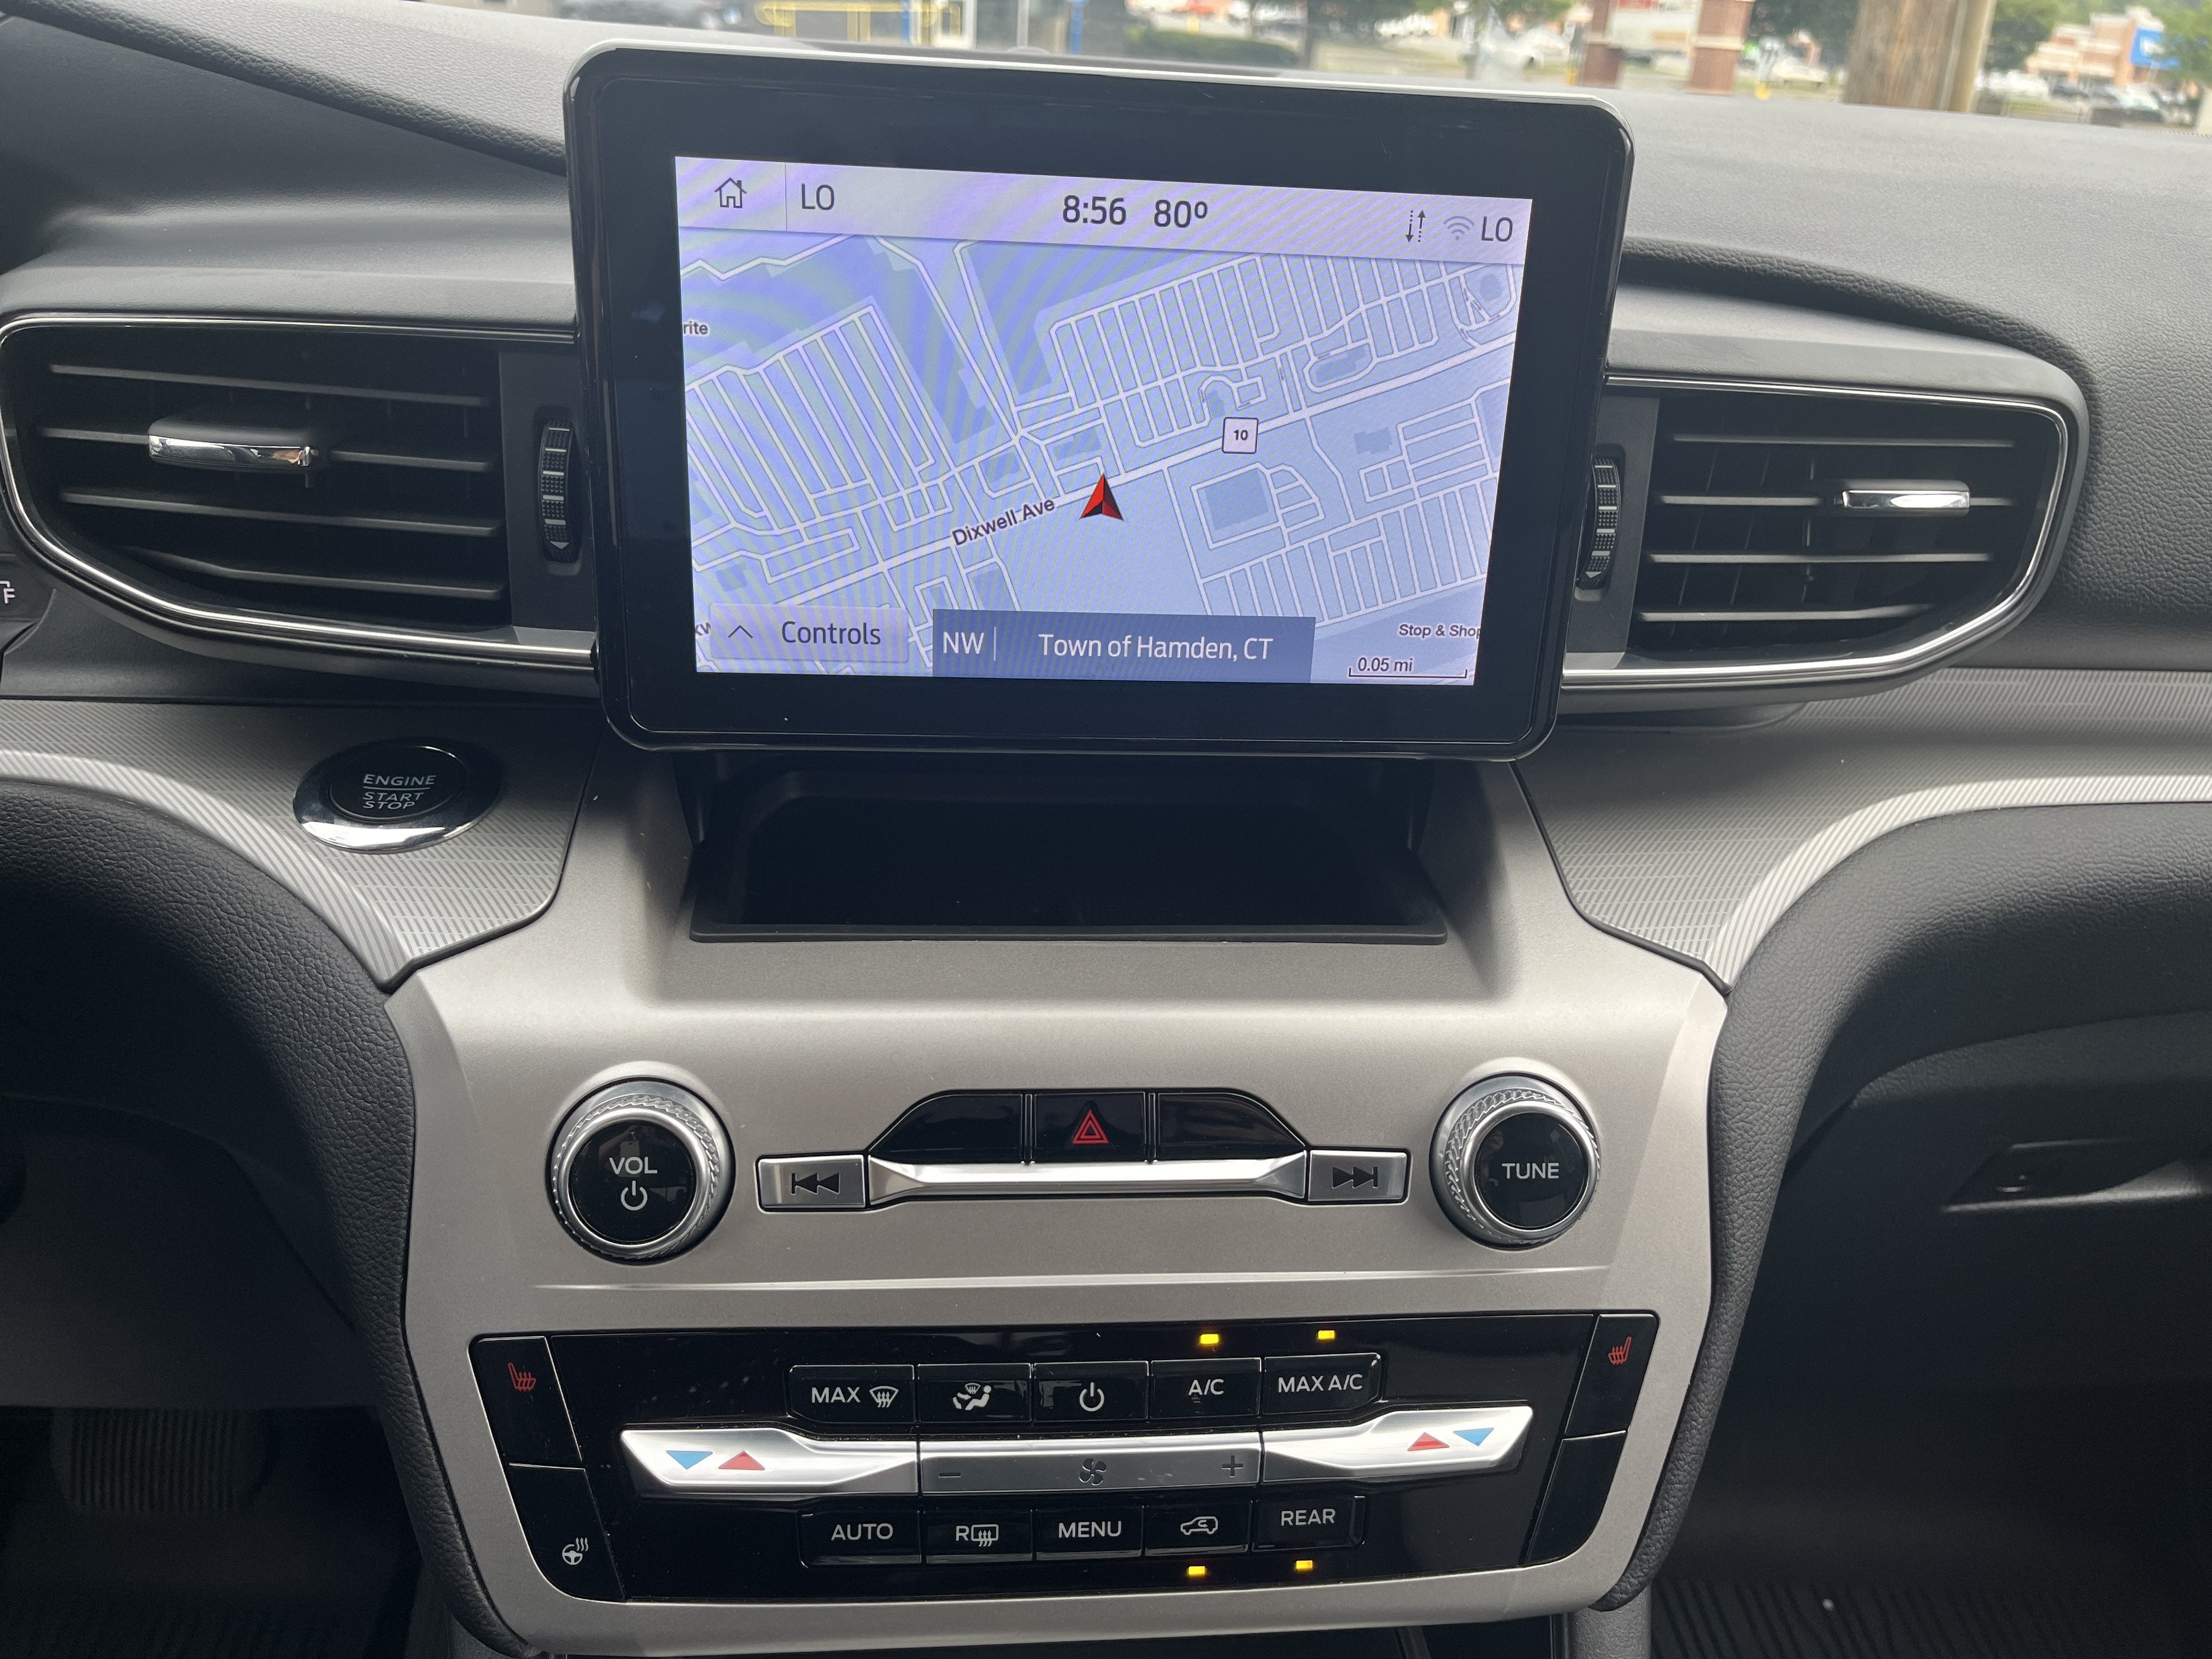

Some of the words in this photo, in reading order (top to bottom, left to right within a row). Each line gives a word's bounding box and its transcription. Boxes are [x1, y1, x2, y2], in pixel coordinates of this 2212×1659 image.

[800, 184, 835, 210] LO
[1063, 195, 1126, 225] 8:56
[1482, 217, 1513, 241] LO
[1233, 429, 1248, 441] 10
[952, 509, 1018, 546] Dixwell
[1023, 499, 1055, 521] Ave
[3, 588, 16, 604] F
[781, 621, 881, 645] Controls
[1399, 623, 1431, 639] Stop
[1435, 624, 1446, 636] &
[943, 632, 984, 654] NW
[1039, 634, 1102, 656] Town
[1108, 635, 1132, 657] of
[1137, 635, 1238, 662] Hamden,
[1244, 637, 1274, 659] CT
[1358, 657, 1389, 672] 0.05
[1393, 658, 1413, 672] mi
[363, 773, 437, 787] ENGINE
[362, 791, 425, 802] START
[363, 800, 415, 810] STOP
[608, 1156, 658, 1175] VOL
[1502, 1162, 1559, 1180] TUNE
[1188, 1379, 1224, 1397] A/C
[1277, 1376, 1325, 1393] MAX
[1328, 1373, 1363, 1391] A/C
[811, 1387, 861, 1403] MAX
[1280, 1508, 1336, 1527] REAR
[831, 1523, 894, 1541] AUTO
[1058, 1520, 1122, 1539] MENU
